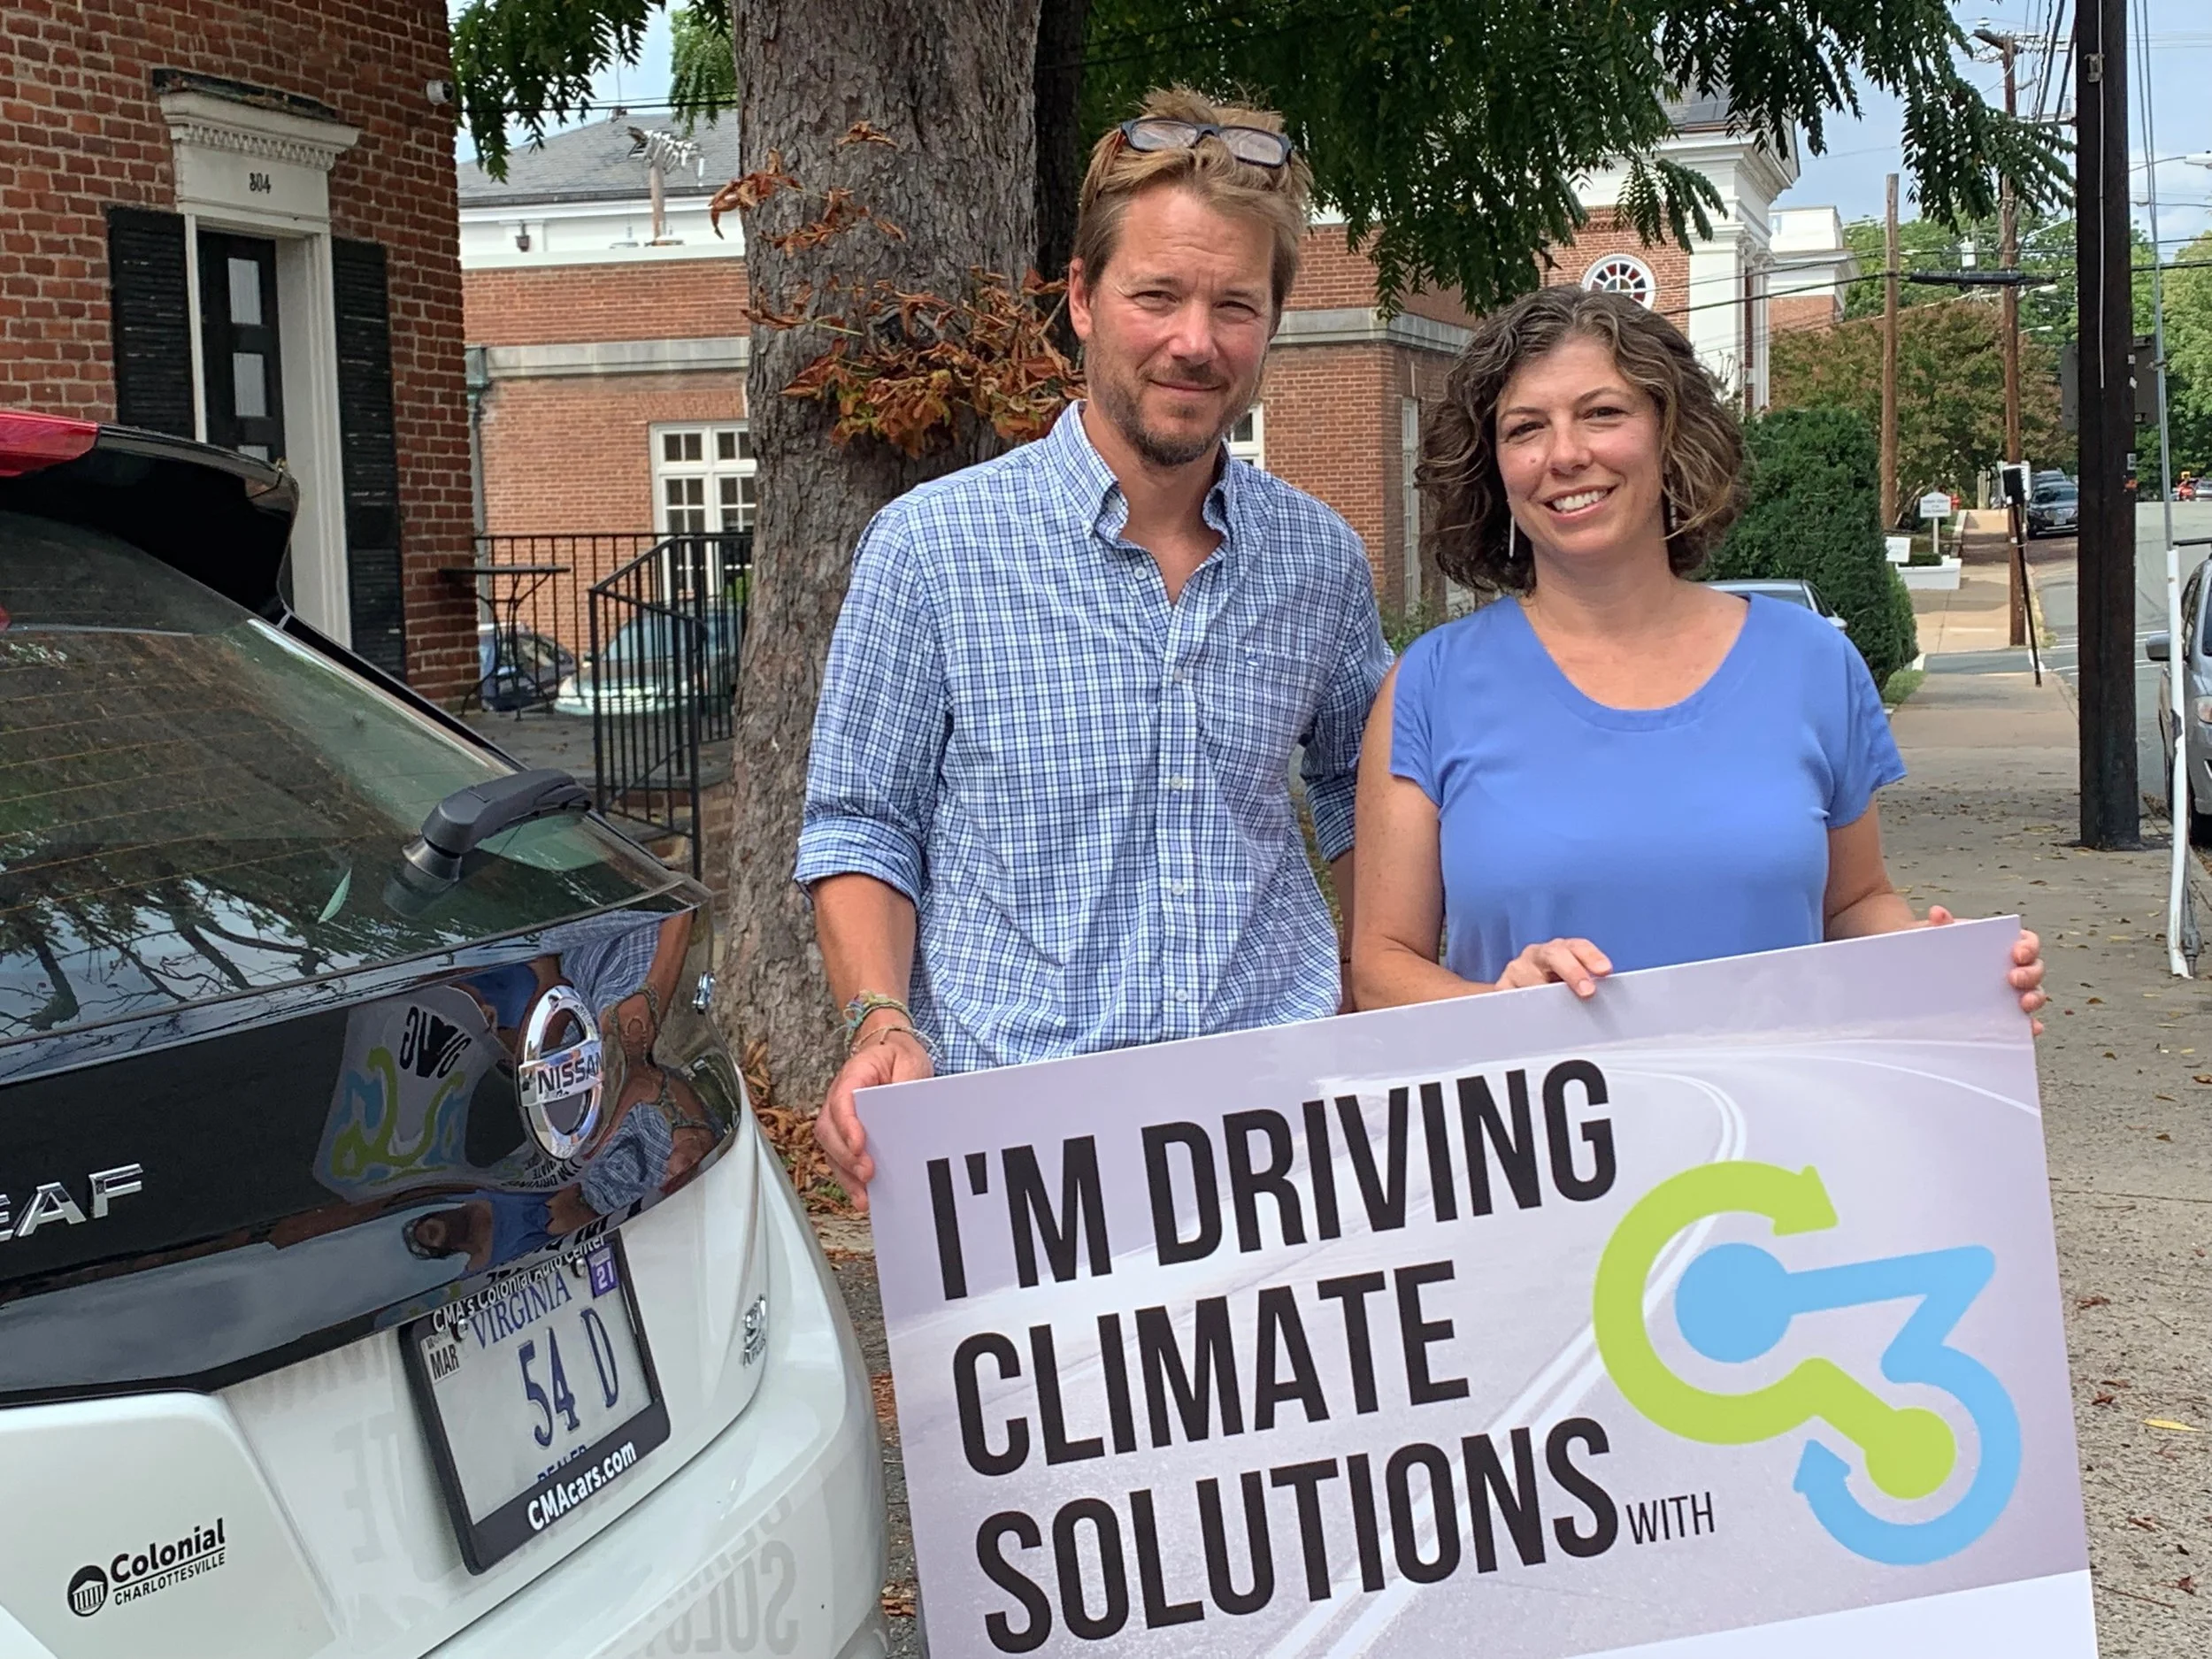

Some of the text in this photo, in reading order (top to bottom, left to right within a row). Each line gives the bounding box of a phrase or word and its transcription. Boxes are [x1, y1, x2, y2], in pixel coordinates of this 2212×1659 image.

[249, 172, 272, 194] 804
[537, 1053, 603, 1094] NISSAN
[0, 1163, 143, 1241] AF
[926, 1059, 1618, 1301] I'M DRIVING
[433, 1300, 475, 1333] CMA's
[477, 1271, 533, 1310] Colonial
[469, 1271, 573, 1350] VIRGINIA
[596, 1260, 614, 1290] 21
[429, 1343, 460, 1380] MAR
[518, 1308, 618, 1448] 54 D
[952, 1260, 1471, 1477] CLIMATE
[527, 1438, 637, 1532] CMAcars.com
[110, 1517, 226, 1584] Colonial
[975, 1417, 1717, 1655] SOLUTIONS WITH
[114, 1552, 227, 1607] CHARLOTTESVILLE
